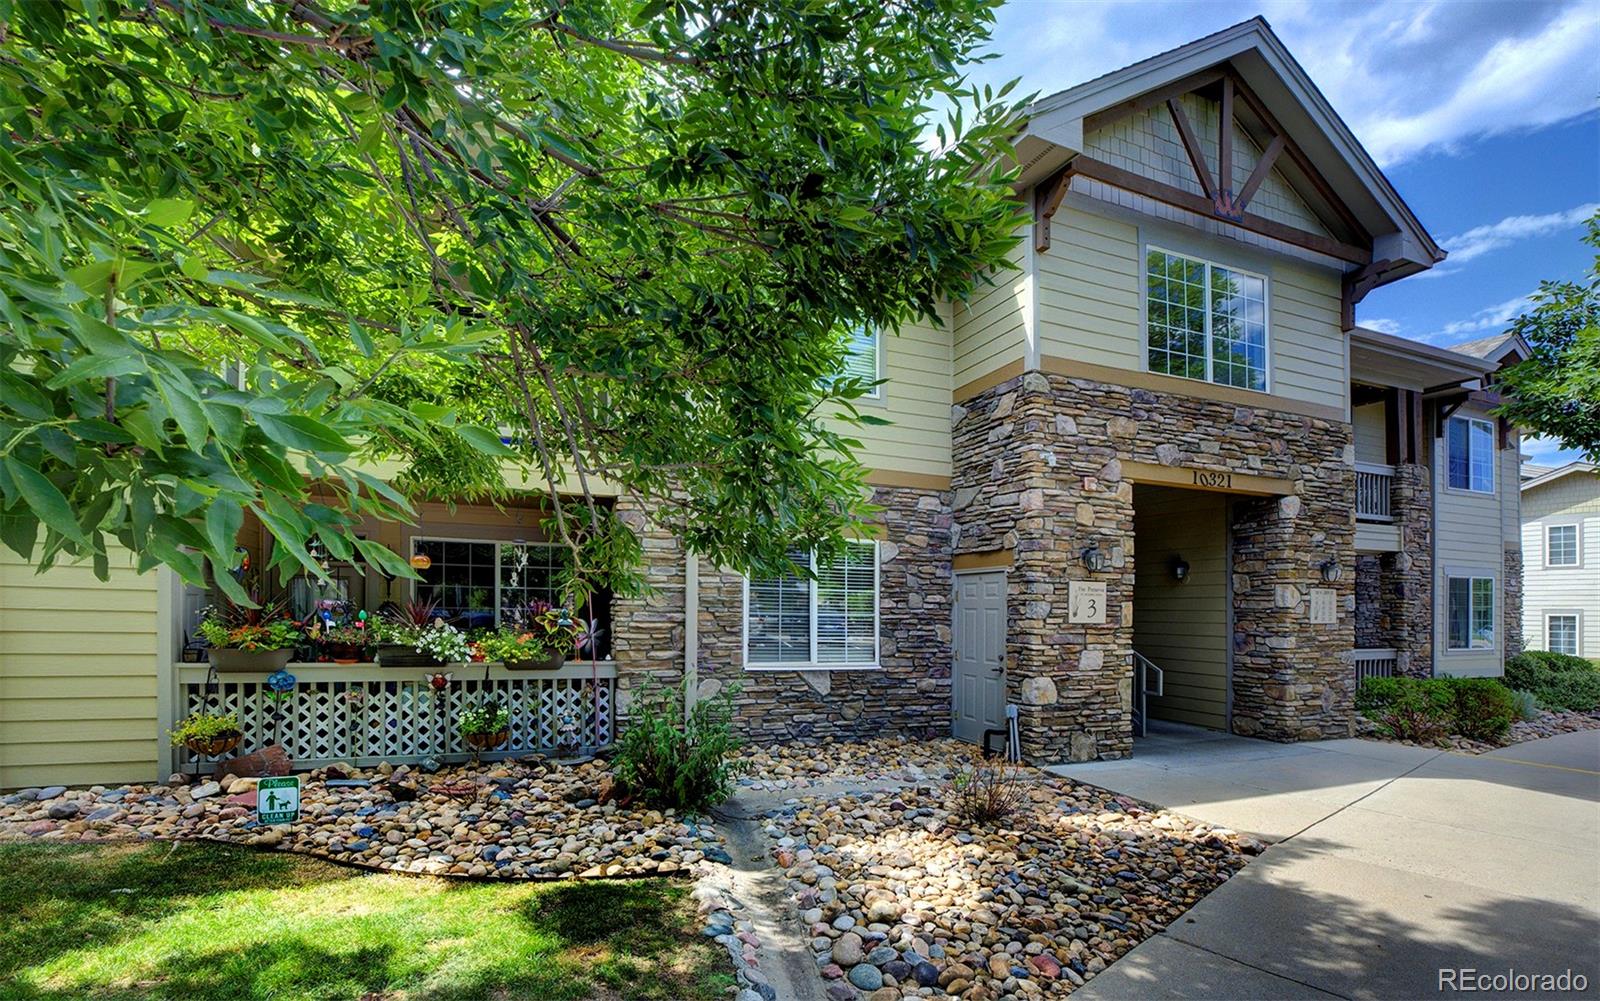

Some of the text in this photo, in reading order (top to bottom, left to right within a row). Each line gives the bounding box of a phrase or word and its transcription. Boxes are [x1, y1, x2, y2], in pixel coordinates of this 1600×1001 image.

[1193, 471, 1231, 488] 10321
[1088, 599, 1096, 618] 3
[263, 779, 294, 787] Please
[261, 812, 285, 820] CLEAN
